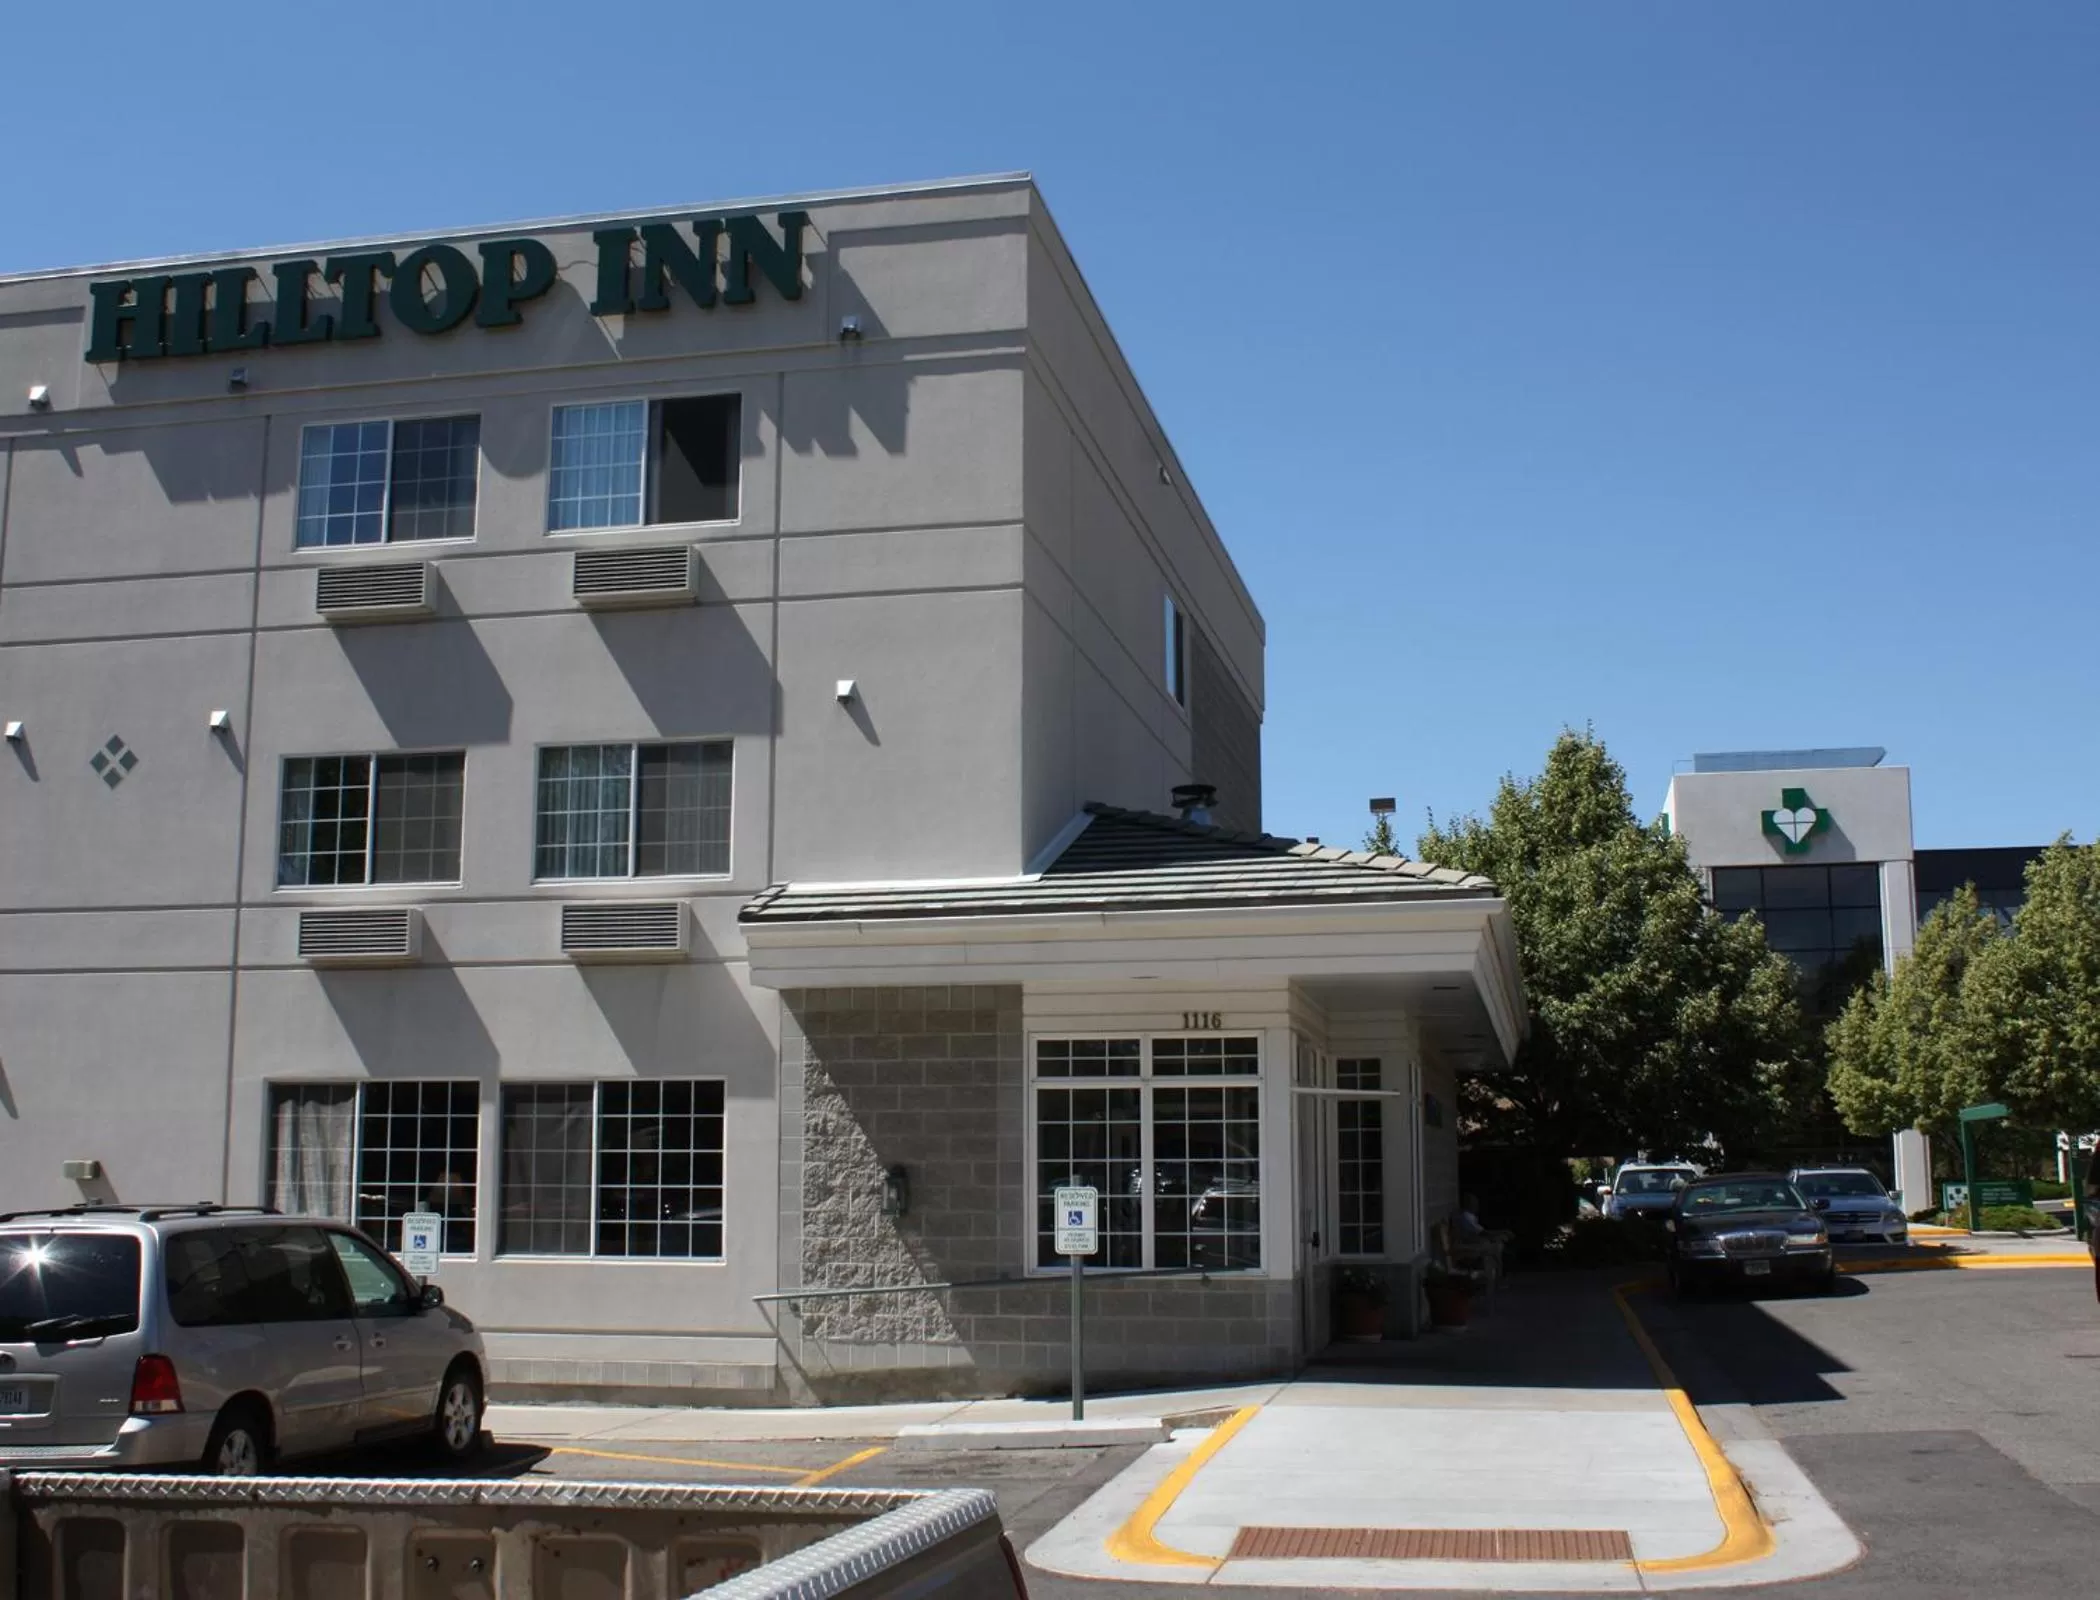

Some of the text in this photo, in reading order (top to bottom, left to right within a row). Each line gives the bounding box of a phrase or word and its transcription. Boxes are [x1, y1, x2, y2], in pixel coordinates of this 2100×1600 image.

[85, 210, 810, 362] HILLTOP INN
[1181, 1010, 1222, 1030] 1116
